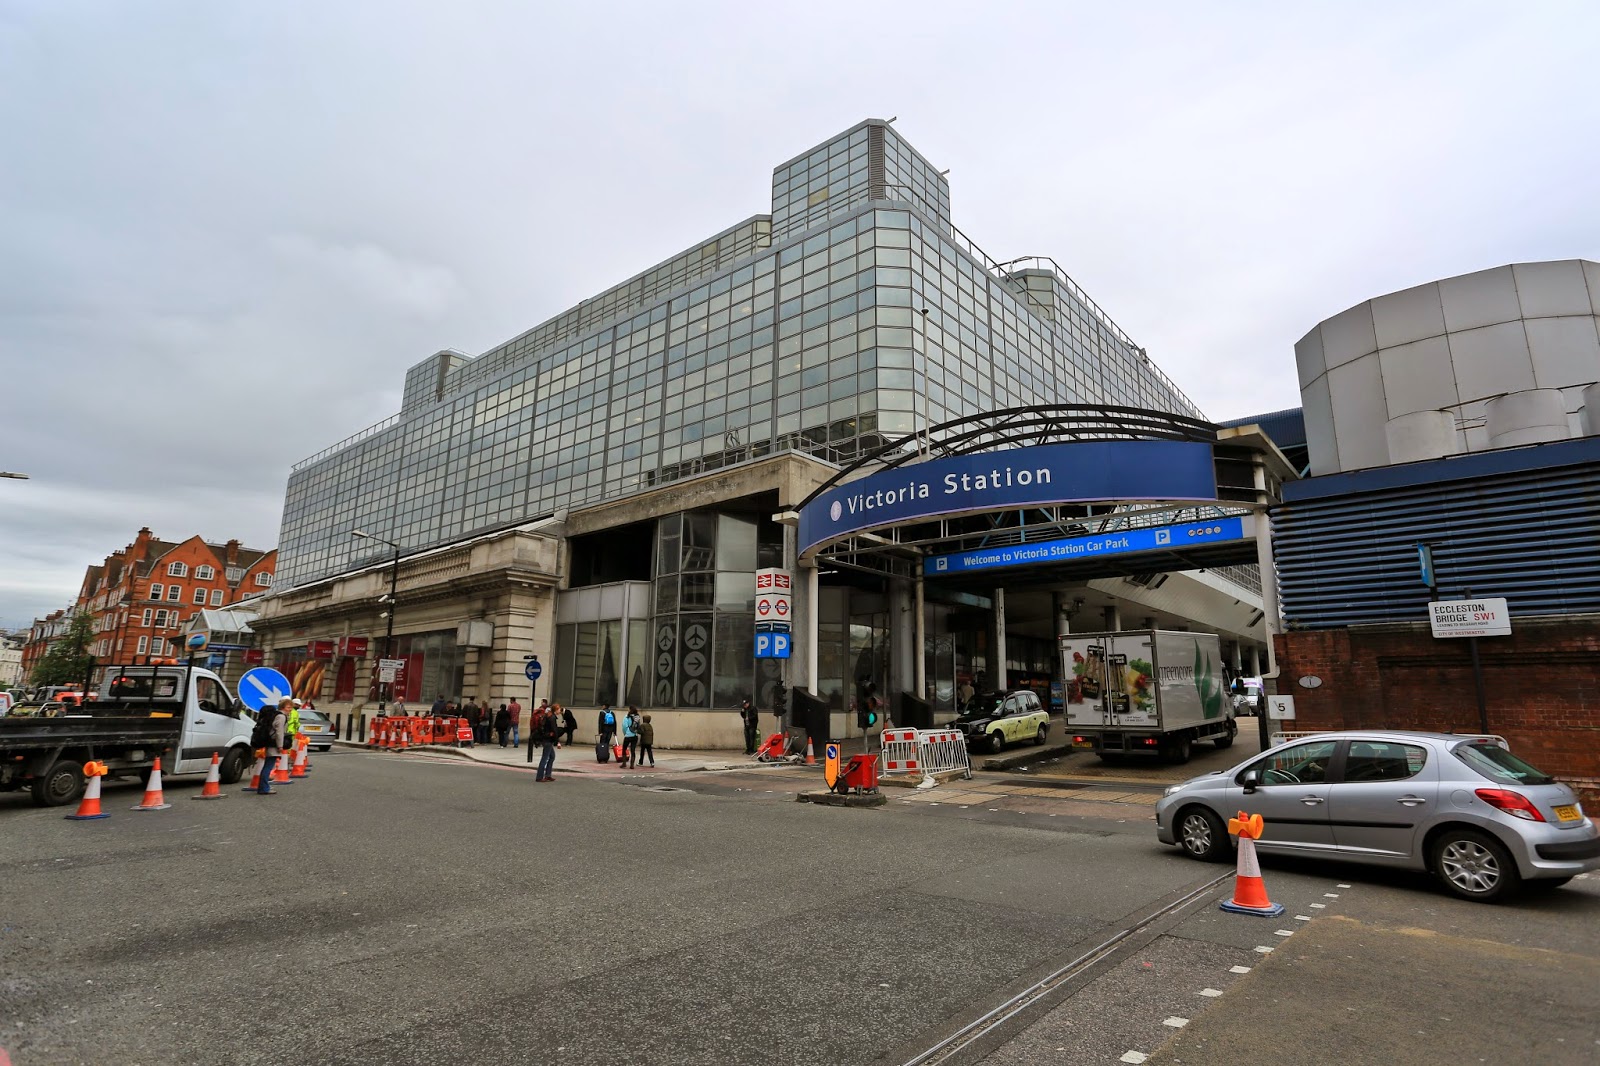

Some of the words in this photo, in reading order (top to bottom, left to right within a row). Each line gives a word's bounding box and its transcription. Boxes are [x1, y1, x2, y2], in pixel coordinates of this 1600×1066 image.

[847, 482, 930, 514] Victoria
[944, 467, 1051, 495] Station
[963, 553, 1001, 566] Welcome
[1003, 551, 1011, 563] to
[1013, 546, 1048, 561] Victoria
[1050, 543, 1086, 557] Station
[1087, 540, 1103, 554] Car
[1105, 538, 1129, 552] Park
[1434, 604, 1485, 614] ECCLESTON
[1436, 614, 1468, 623] BRIDGE
[1474, 612, 1495, 621] SW1
[1158, 665, 1193, 687] greencore
[1278, 703, 1286, 712] 5
